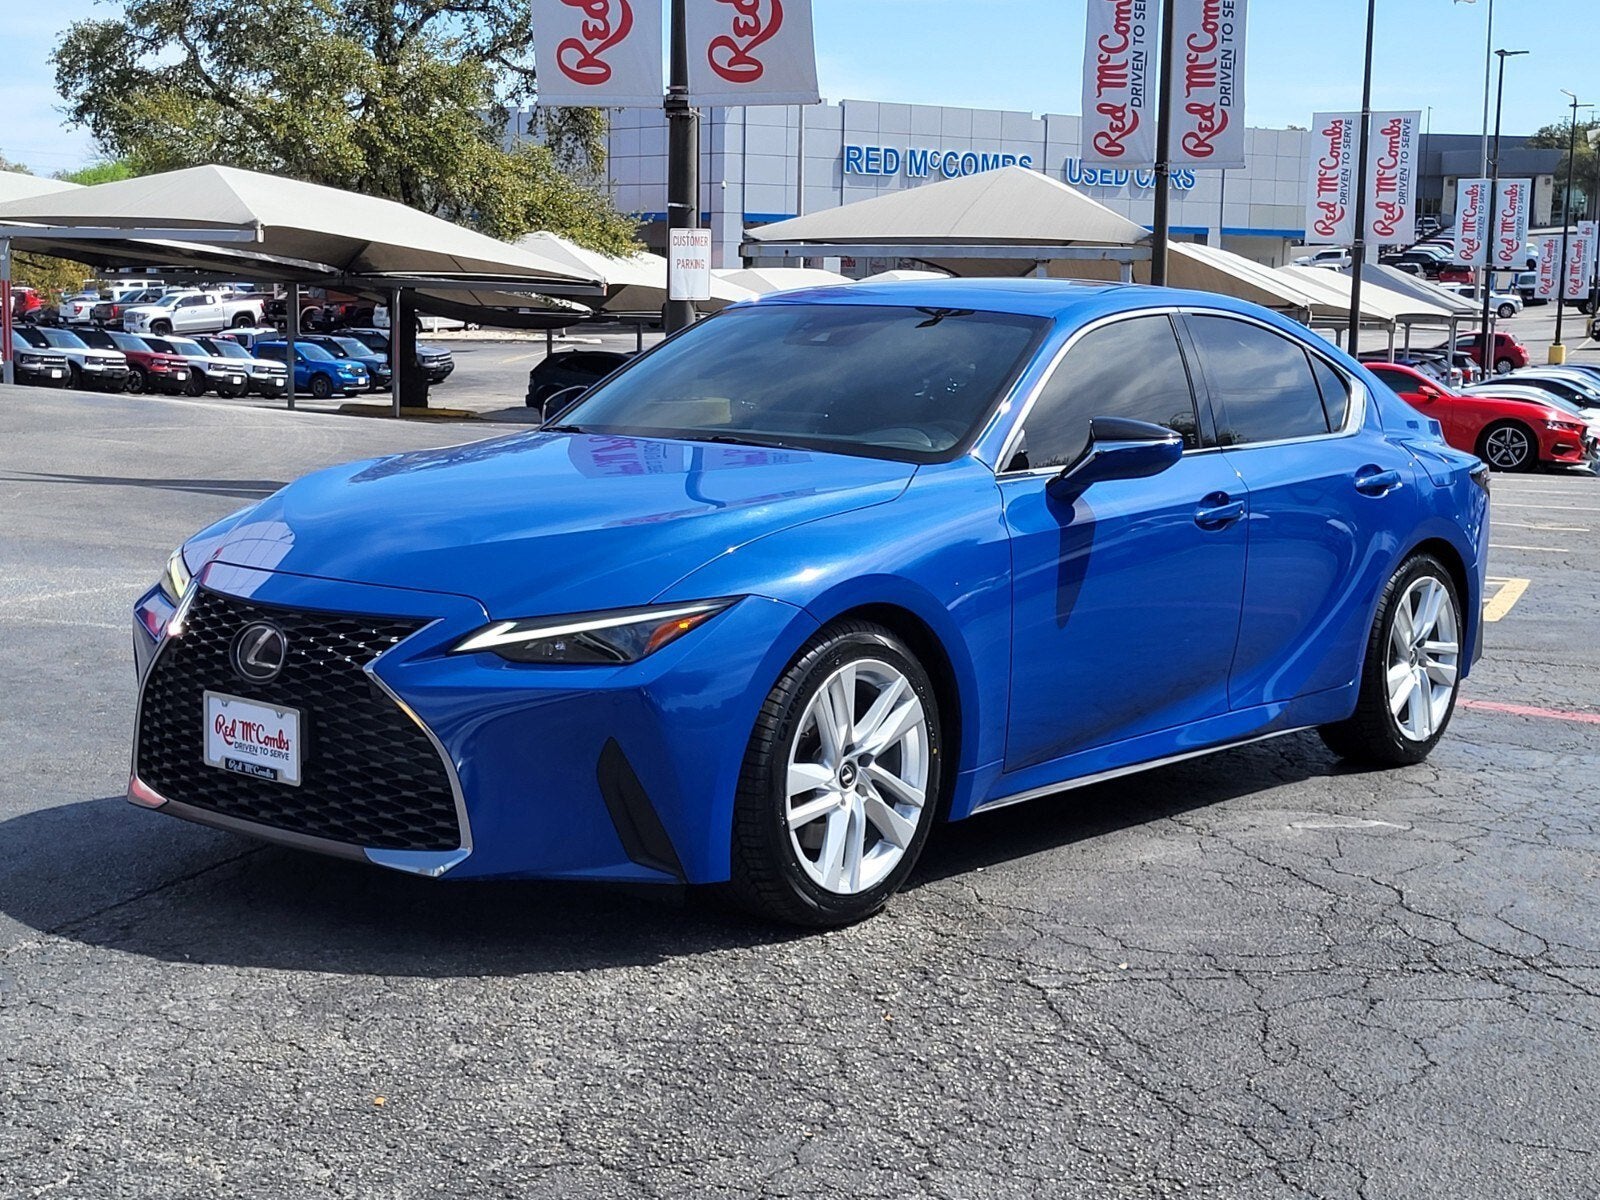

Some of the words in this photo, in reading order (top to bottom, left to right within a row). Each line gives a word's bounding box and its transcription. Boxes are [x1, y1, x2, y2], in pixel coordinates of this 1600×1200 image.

[1133, 25, 1145, 45] TO
[1221, 23, 1234, 44] TO
[1131, 50, 1147, 108] DRIVEN
[1219, 49, 1235, 107] DRIVEN
[1093, 102, 1140, 157] Red
[1181, 102, 1229, 158] Red
[1343, 118, 1353, 150] SERVE
[1401, 117, 1412, 149] SERVE
[844, 144, 901, 175] RED
[1066, 157, 1129, 187] USED
[1135, 169, 1196, 190] CRS
[1317, 119, 1344, 198] McCombs
[1342, 151, 1350, 165] TO
[1375, 118, 1402, 198] McCombs
[1400, 151, 1409, 164] TO
[1340, 168, 1351, 205] DRIVEN
[1398, 167, 1409, 205] DRIVEN
[1314, 201, 1345, 236] Red
[1373, 201, 1404, 236] Red
[1462, 183, 1479, 235] McCombs
[1501, 183, 1518, 236] McCombs
[672, 235, 709, 247] CUSTOMER
[1459, 237, 1481, 261] Red
[1498, 237, 1520, 261] Red
[676, 258, 705, 270] PARKING
[215, 713, 237, 746] Red
[238, 719, 290, 752] McCombs
[234, 741, 258, 755] DRIVEN
[259, 746, 269, 756] TO
[269, 749, 290, 761] SERVE
